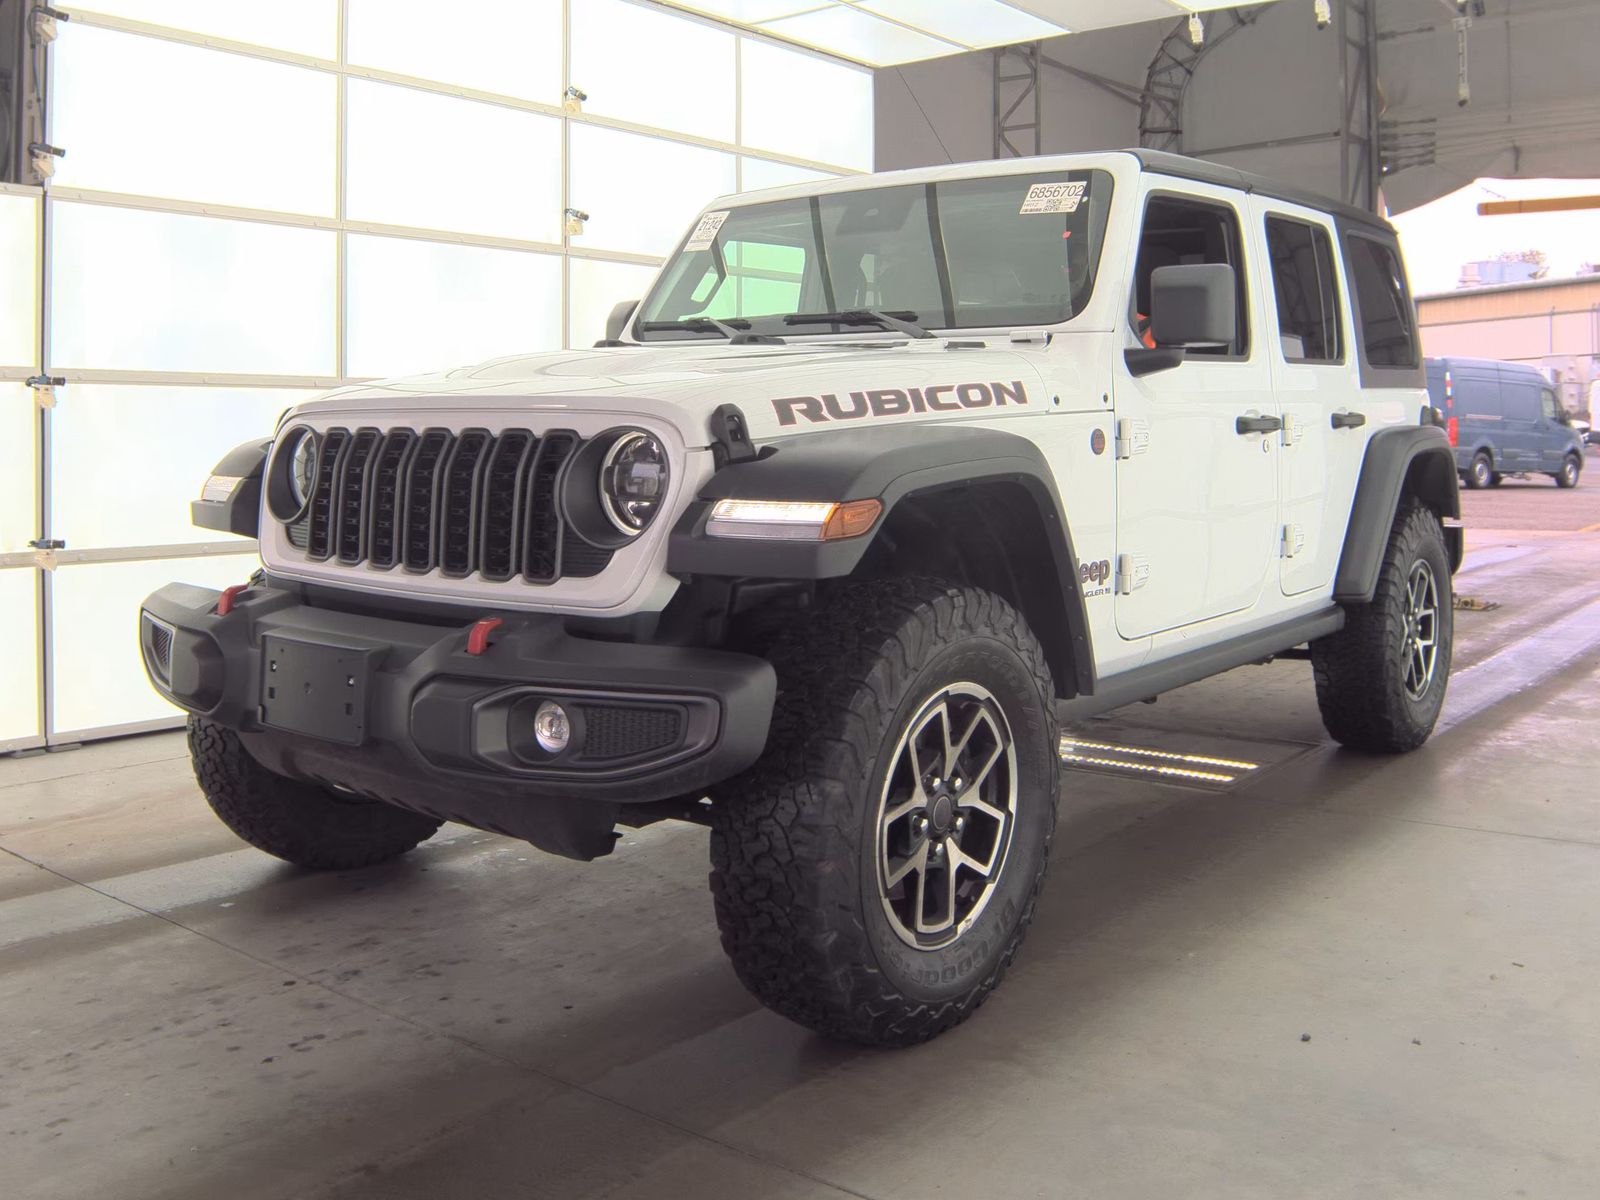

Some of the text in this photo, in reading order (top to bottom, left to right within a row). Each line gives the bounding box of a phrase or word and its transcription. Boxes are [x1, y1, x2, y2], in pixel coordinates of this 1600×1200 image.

[1030, 185, 1084, 198] 6856702
[771, 380, 1027, 426] RUBICON
[1077, 559, 1110, 585] eep
